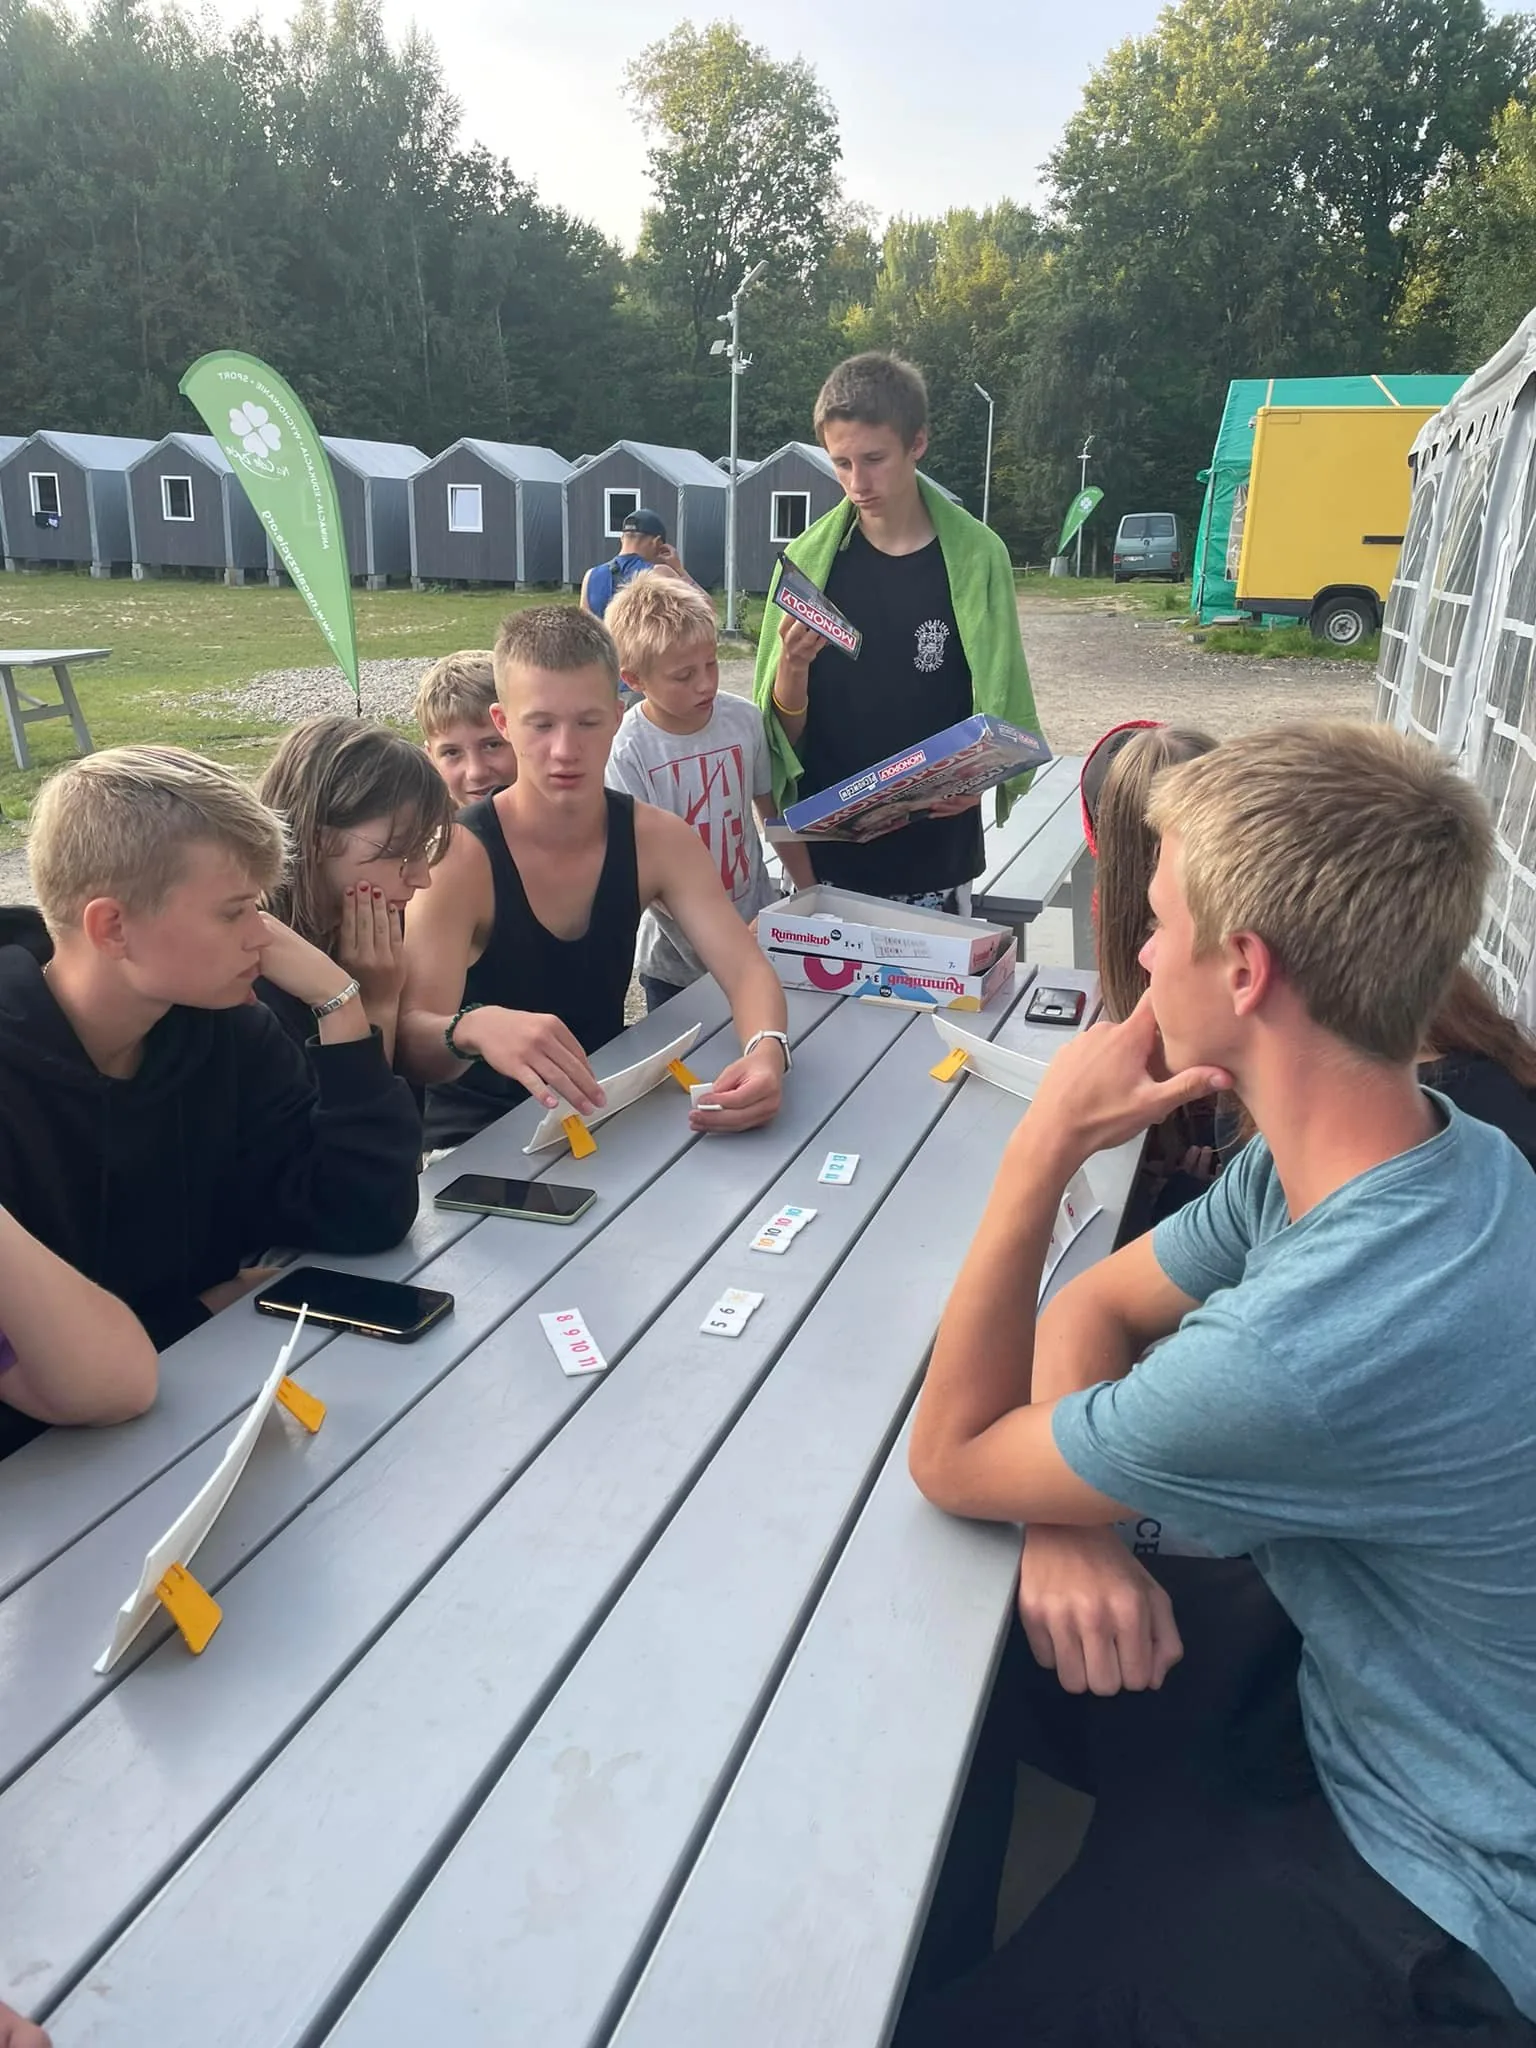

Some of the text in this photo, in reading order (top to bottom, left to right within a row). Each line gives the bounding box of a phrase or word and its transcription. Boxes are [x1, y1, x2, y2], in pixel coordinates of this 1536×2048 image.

[784, 589, 855, 648] MONOPOLY
[880, 752, 923, 780] MONOPOLY
[817, 742, 984, 832] MONOPOLY
[771, 928, 830, 947] Rummikub
[873, 974, 880, 983] 3
[887, 975, 965, 996] Rummikub
[829, 1163, 844, 1171] 12
[775, 1217, 792, 1227] 10
[764, 1227, 781, 1236] 10
[758, 1238, 775, 1247] 10
[719, 1307, 735, 1315] 6
[556, 1314, 598, 1367] 8 9 10 11
